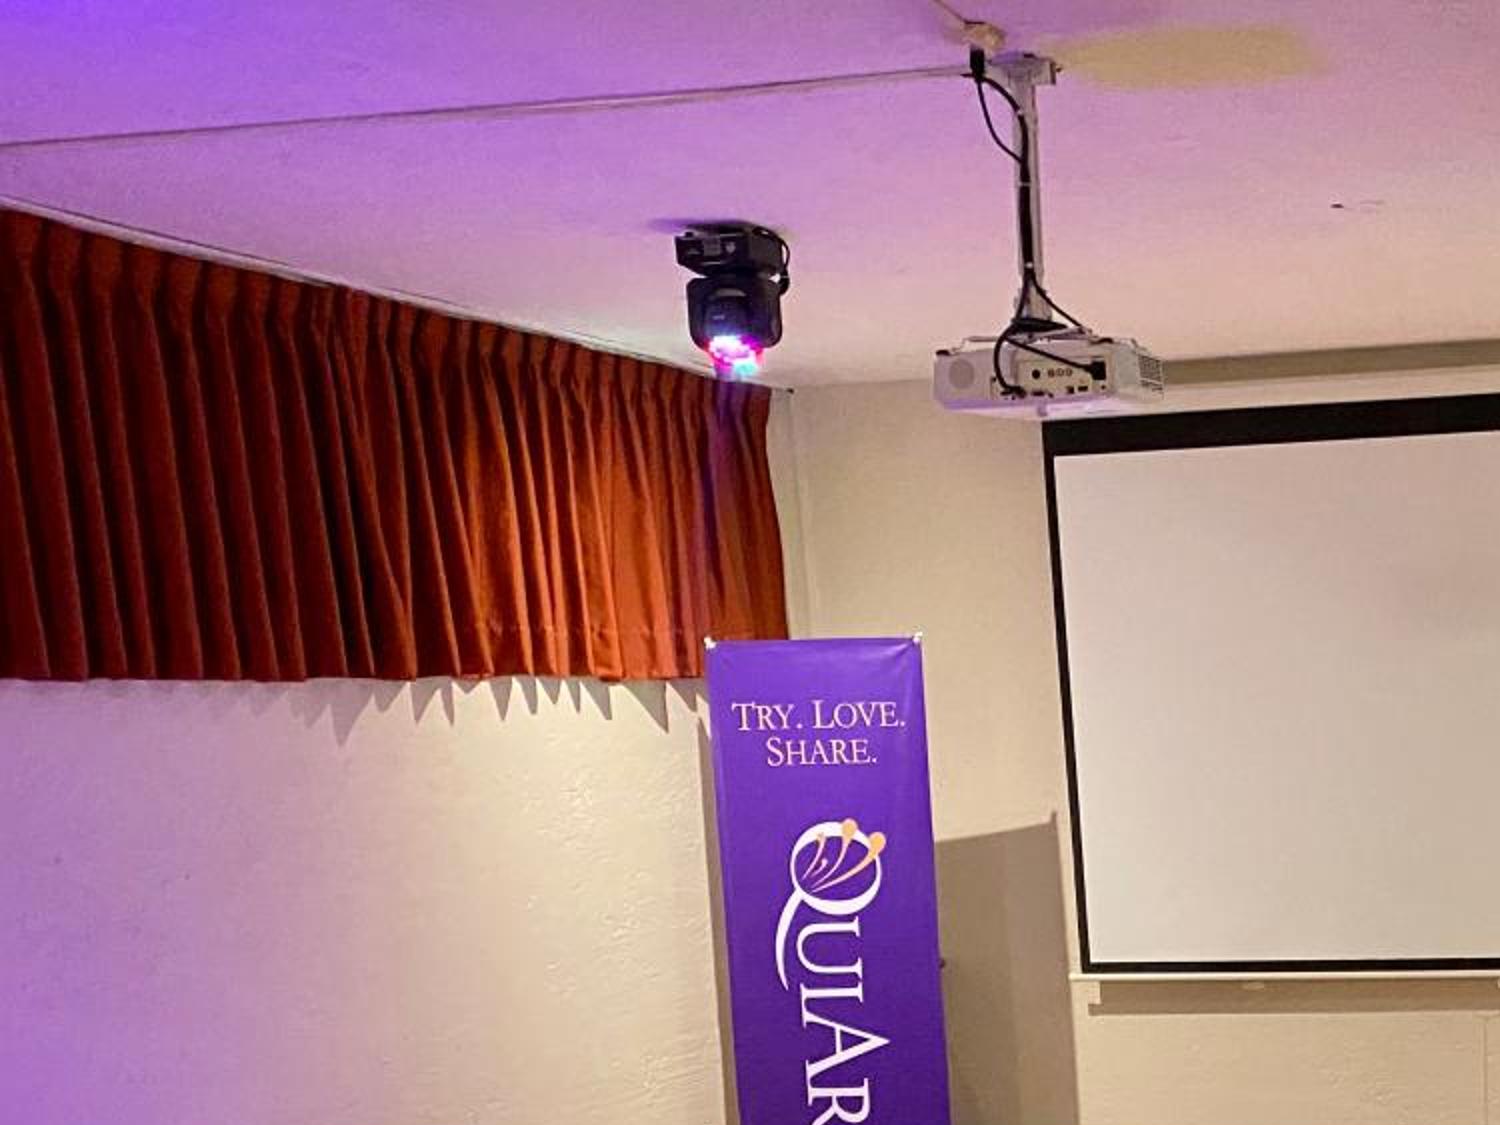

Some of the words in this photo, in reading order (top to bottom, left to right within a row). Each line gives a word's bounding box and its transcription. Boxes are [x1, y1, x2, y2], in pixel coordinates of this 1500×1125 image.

[731, 701, 803, 731] TRY.
[812, 699, 906, 729] LOVE.
[766, 736, 877, 767] SHARE.
